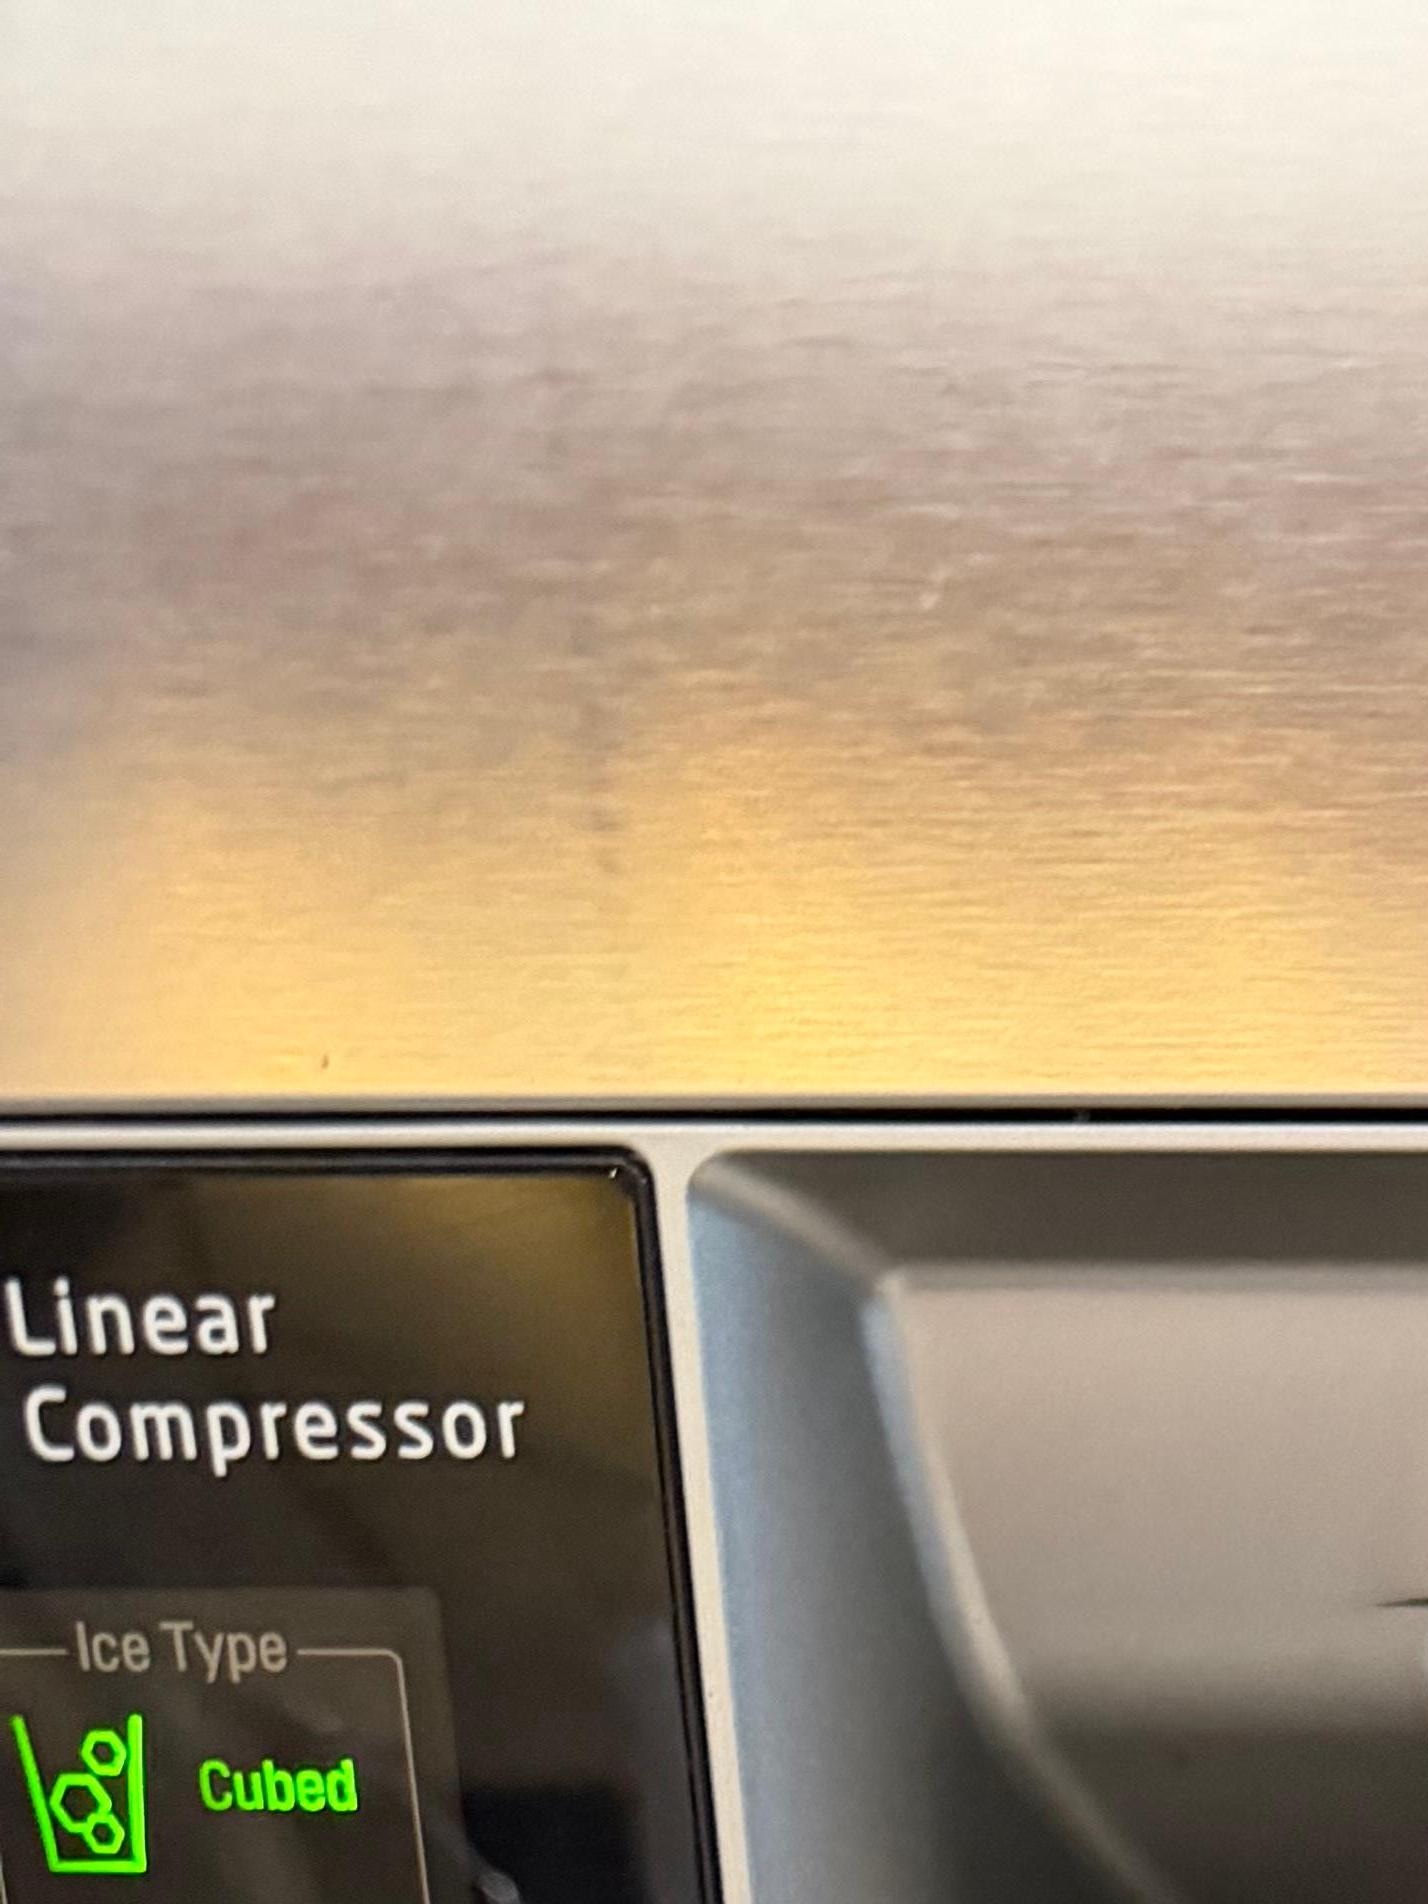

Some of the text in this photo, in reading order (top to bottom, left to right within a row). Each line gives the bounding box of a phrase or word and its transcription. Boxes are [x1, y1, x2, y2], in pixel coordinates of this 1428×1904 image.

[4, 1276, 276, 1357] Linear
[25, 1385, 525, 1477] Compressor
[75, 1621, 289, 1683] Ice Type
[200, 1758, 359, 1813] Cubed
